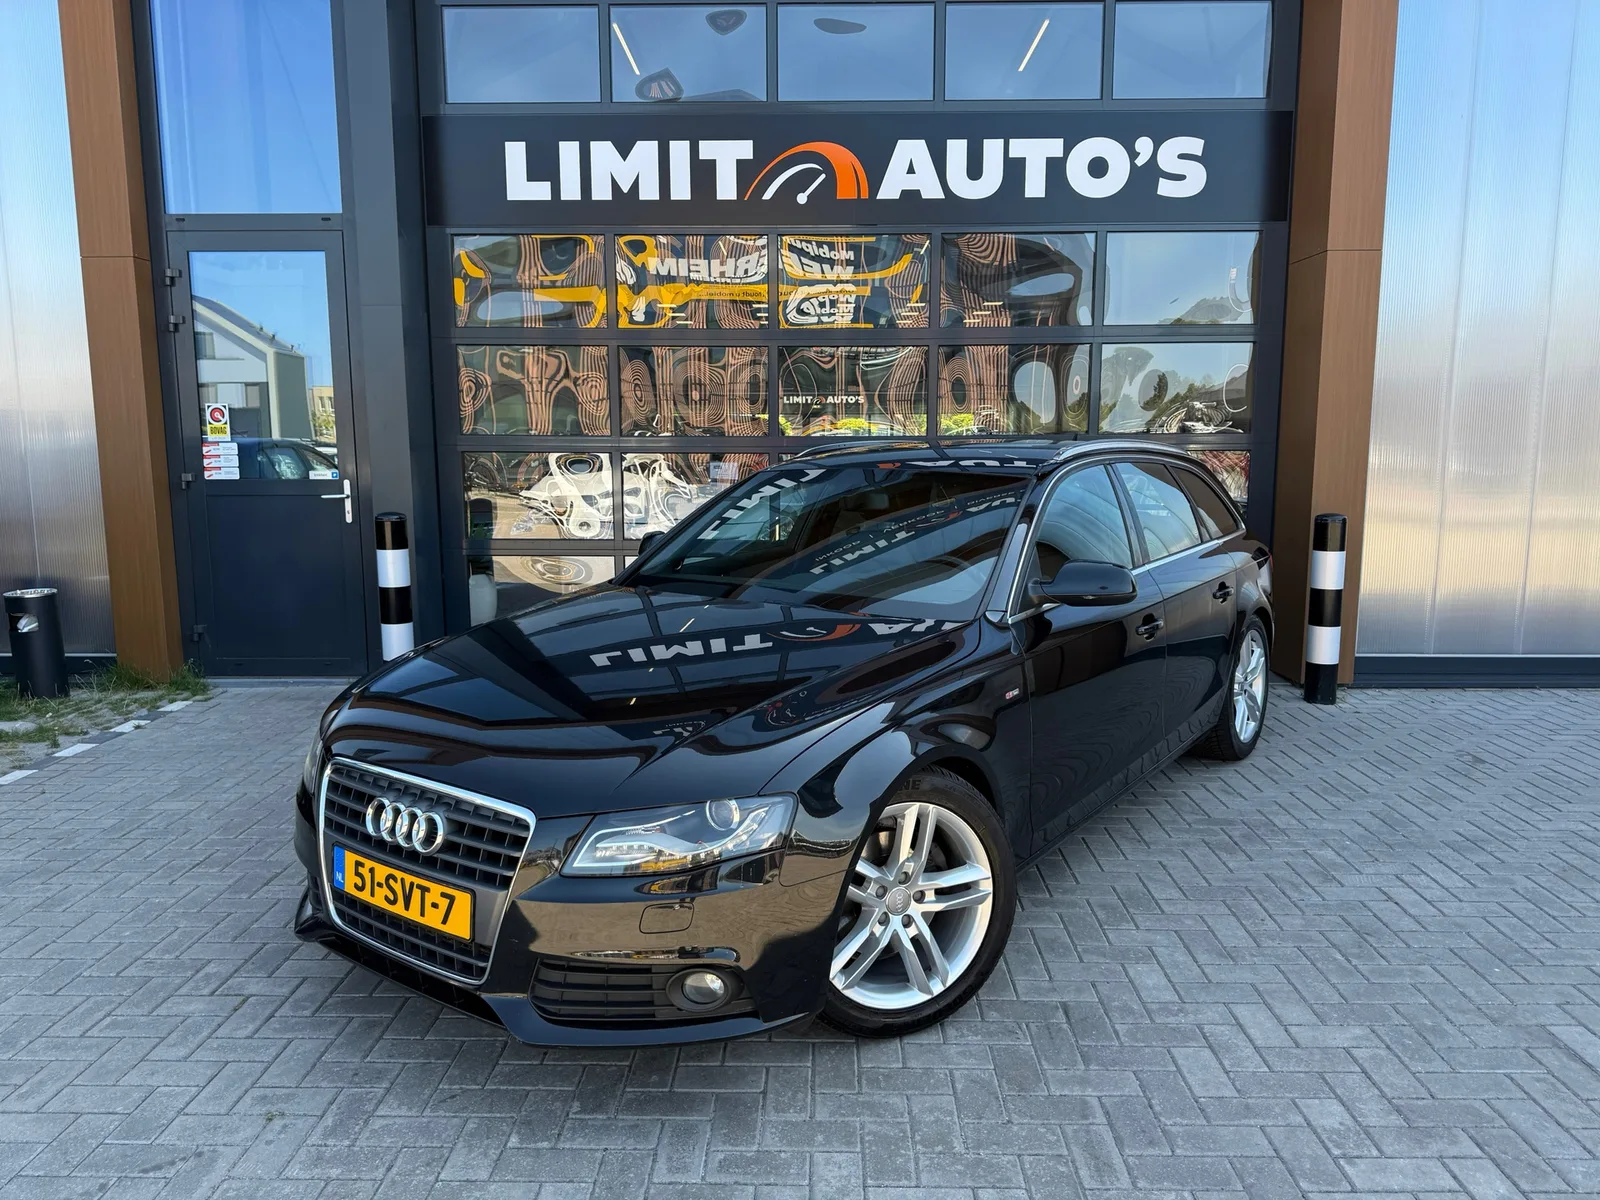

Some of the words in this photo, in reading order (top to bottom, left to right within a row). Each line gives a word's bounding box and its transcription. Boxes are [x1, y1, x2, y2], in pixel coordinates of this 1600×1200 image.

[505, 139, 753, 202] LIMIT
[878, 136, 1207, 200] AUTO'S
[783, 395, 813, 404] LIMIT
[827, 395, 865, 404] AUTO'S
[210, 426, 227, 435] BOVAG
[336, 871, 344, 883] NL
[353, 859, 456, 926] 51-SVT-7
